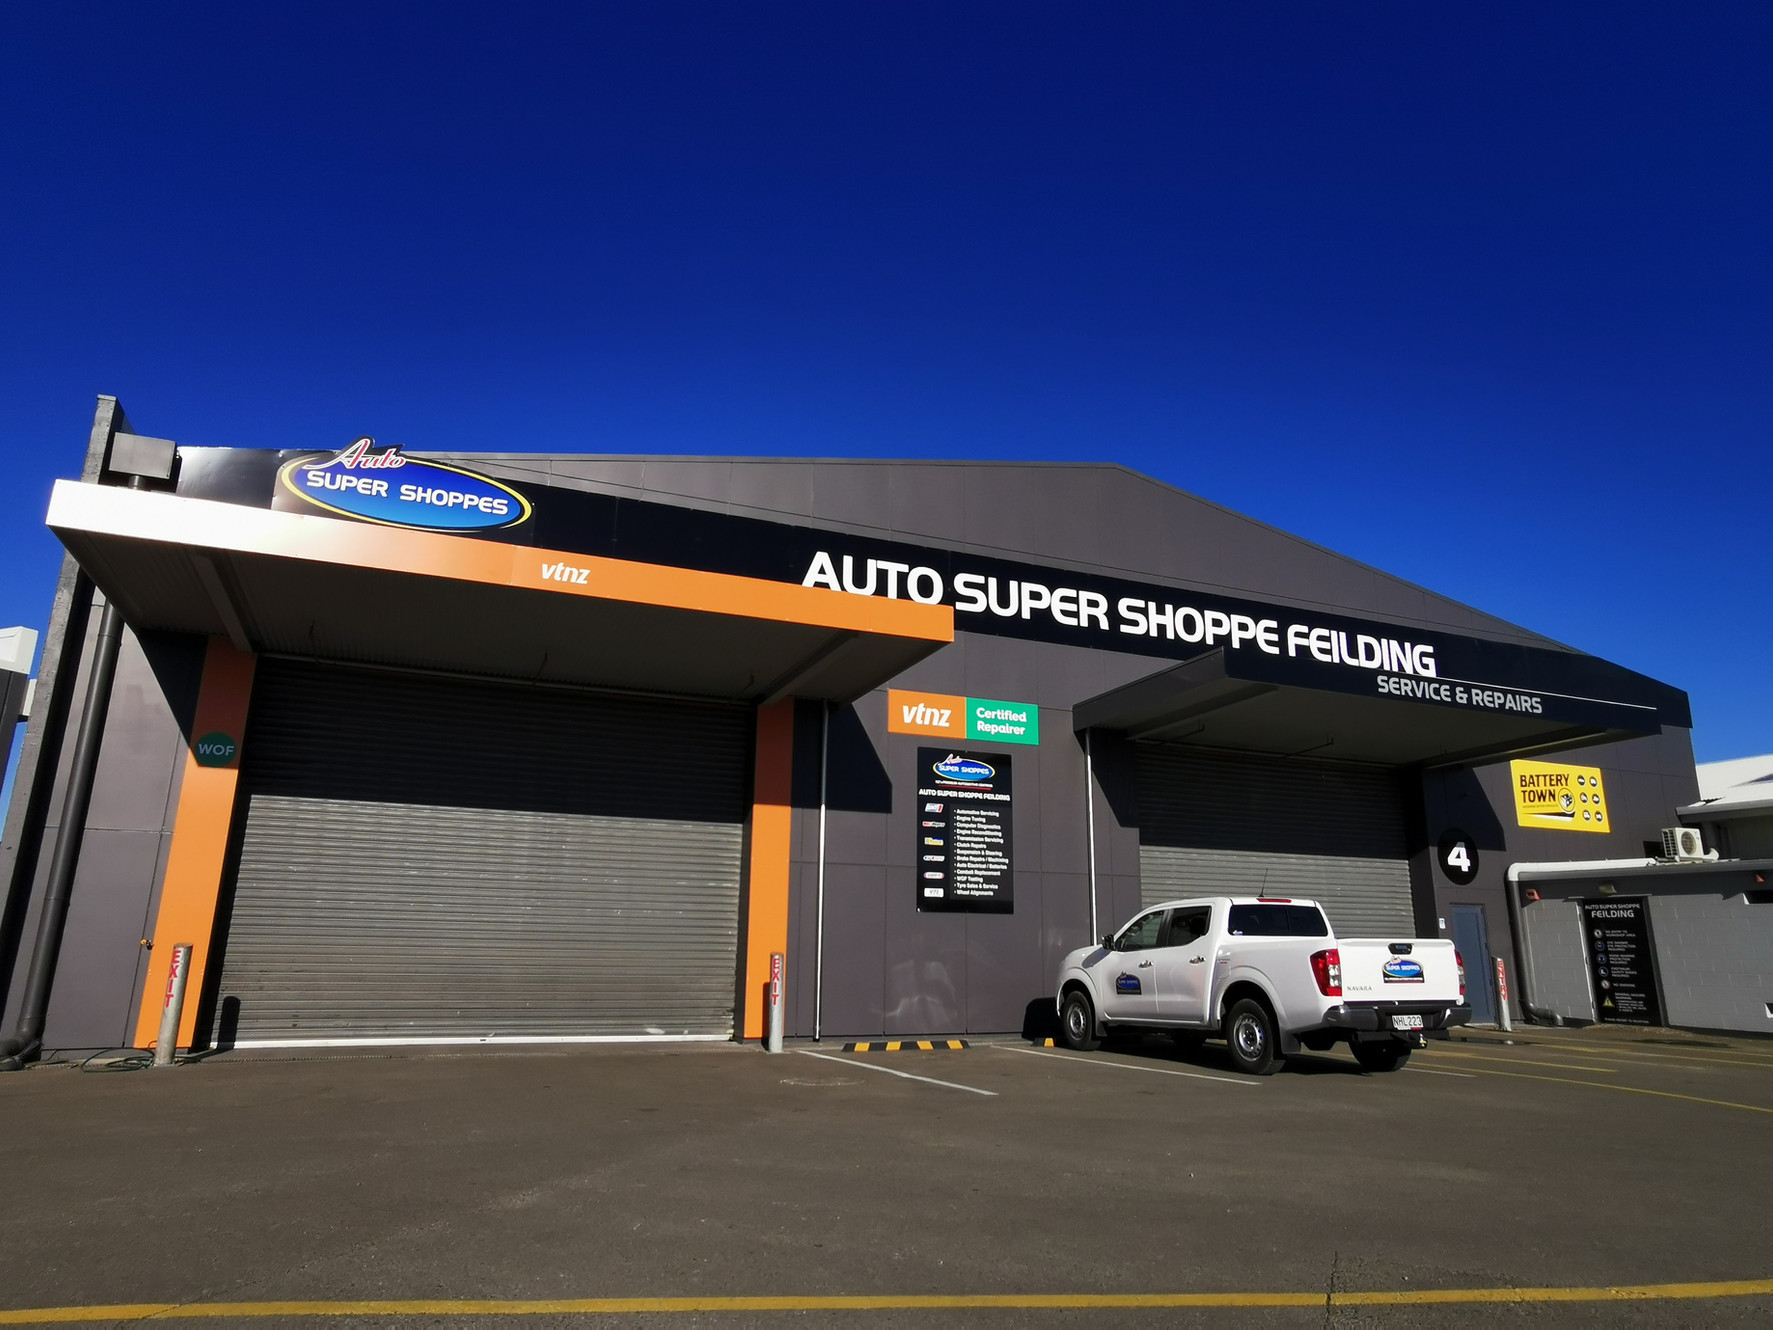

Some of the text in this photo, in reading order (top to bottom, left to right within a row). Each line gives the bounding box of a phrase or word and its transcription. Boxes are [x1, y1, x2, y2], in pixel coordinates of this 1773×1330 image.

[302, 438, 407, 470] Auto
[306, 471, 509, 515] SUPER SHOPPES
[541, 562, 591, 585] vtnz
[801, 551, 1437, 678] AUTO SUPER SHOPPE FEILDING
[1377, 675, 1543, 714] SERVICE & REPAIRS
[902, 703, 952, 728] vtnz
[976, 707, 1027, 723] Certified
[977, 720, 1026, 735] Repairer
[198, 743, 235, 756] WOF
[919, 788, 937, 796] AUTO
[937, 790, 958, 798] SUPER
[1520, 774, 1570, 788] BATTERY
[1521, 789, 1557, 803] TOWN
[1447, 841, 1471, 872] 4
[1591, 910, 1635, 918] FEILDING
[165, 950, 181, 1008] EXIT
[771, 958, 780, 1006] EXIT
[1498, 960, 1508, 1001] ENTRY
[1393, 1016, 1422, 1027] NHL223
